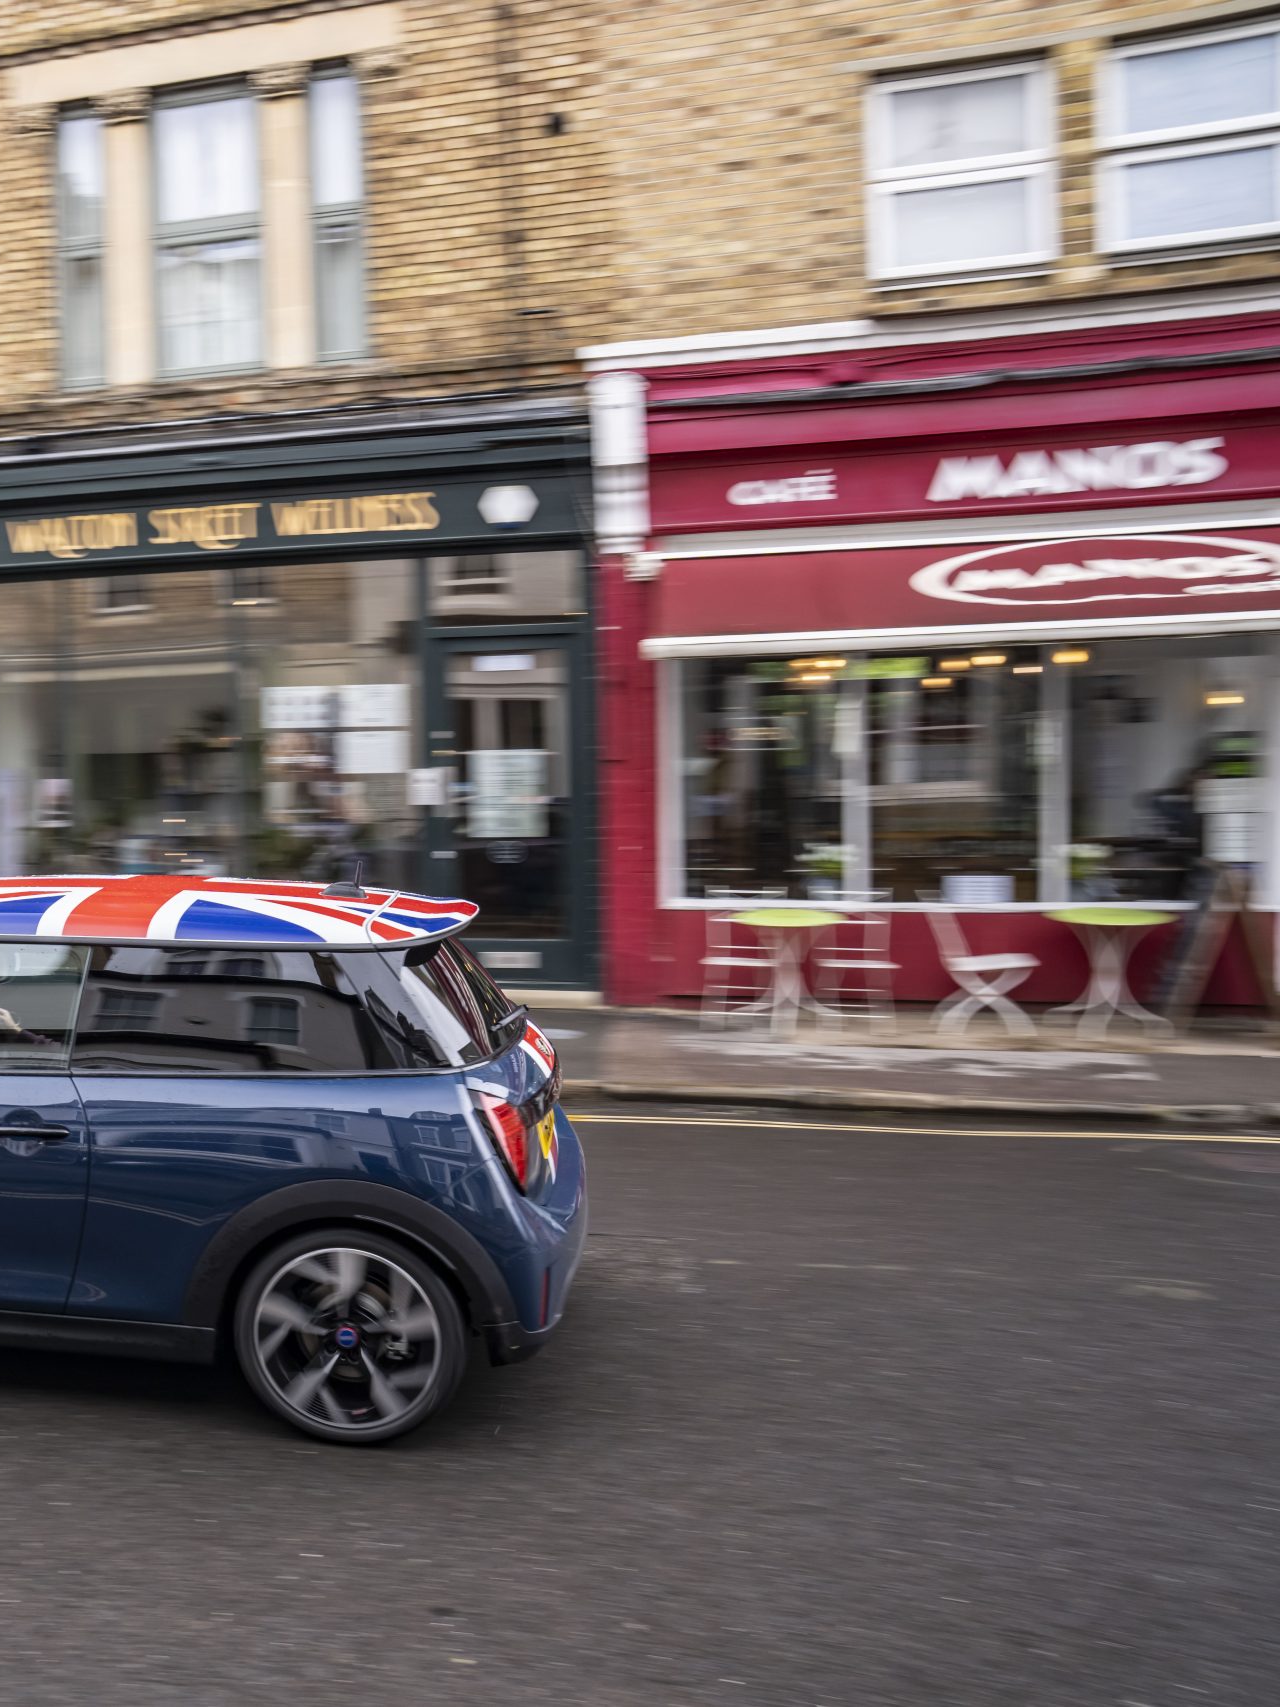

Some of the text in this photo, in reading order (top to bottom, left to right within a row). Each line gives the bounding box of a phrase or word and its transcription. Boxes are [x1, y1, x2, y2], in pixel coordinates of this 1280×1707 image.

[925, 436, 1229, 502] MANOS
[148, 502, 262, 550] STREET
[270, 491, 441, 537] WELLNESS
